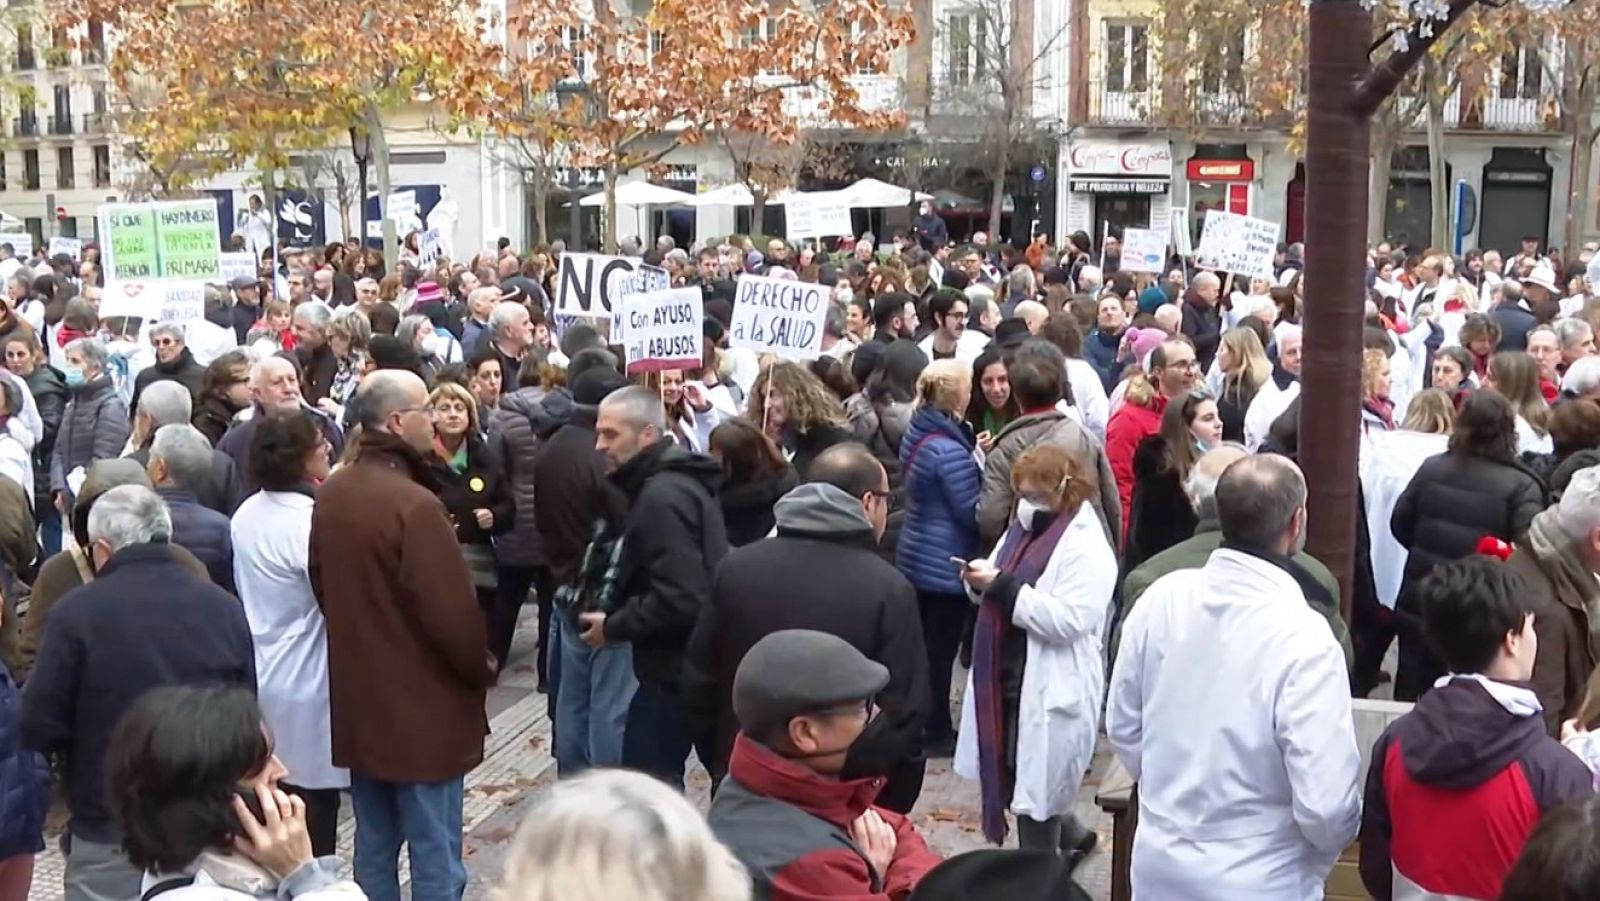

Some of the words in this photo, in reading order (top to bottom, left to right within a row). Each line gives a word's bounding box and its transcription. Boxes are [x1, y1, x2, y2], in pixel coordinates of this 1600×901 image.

[123, 215, 142, 227] QUE
[166, 259, 220, 276] PRIMARIA
[740, 280, 820, 313] DERECHO
[630, 310, 649, 329] Con
[653, 303, 696, 327] AYUSO,
[734, 322, 745, 341] a
[750, 313, 764, 342] la
[766, 315, 817, 350] SALUD.
[630, 343, 644, 361] mil
[650, 335, 697, 357] ABUSOS.
